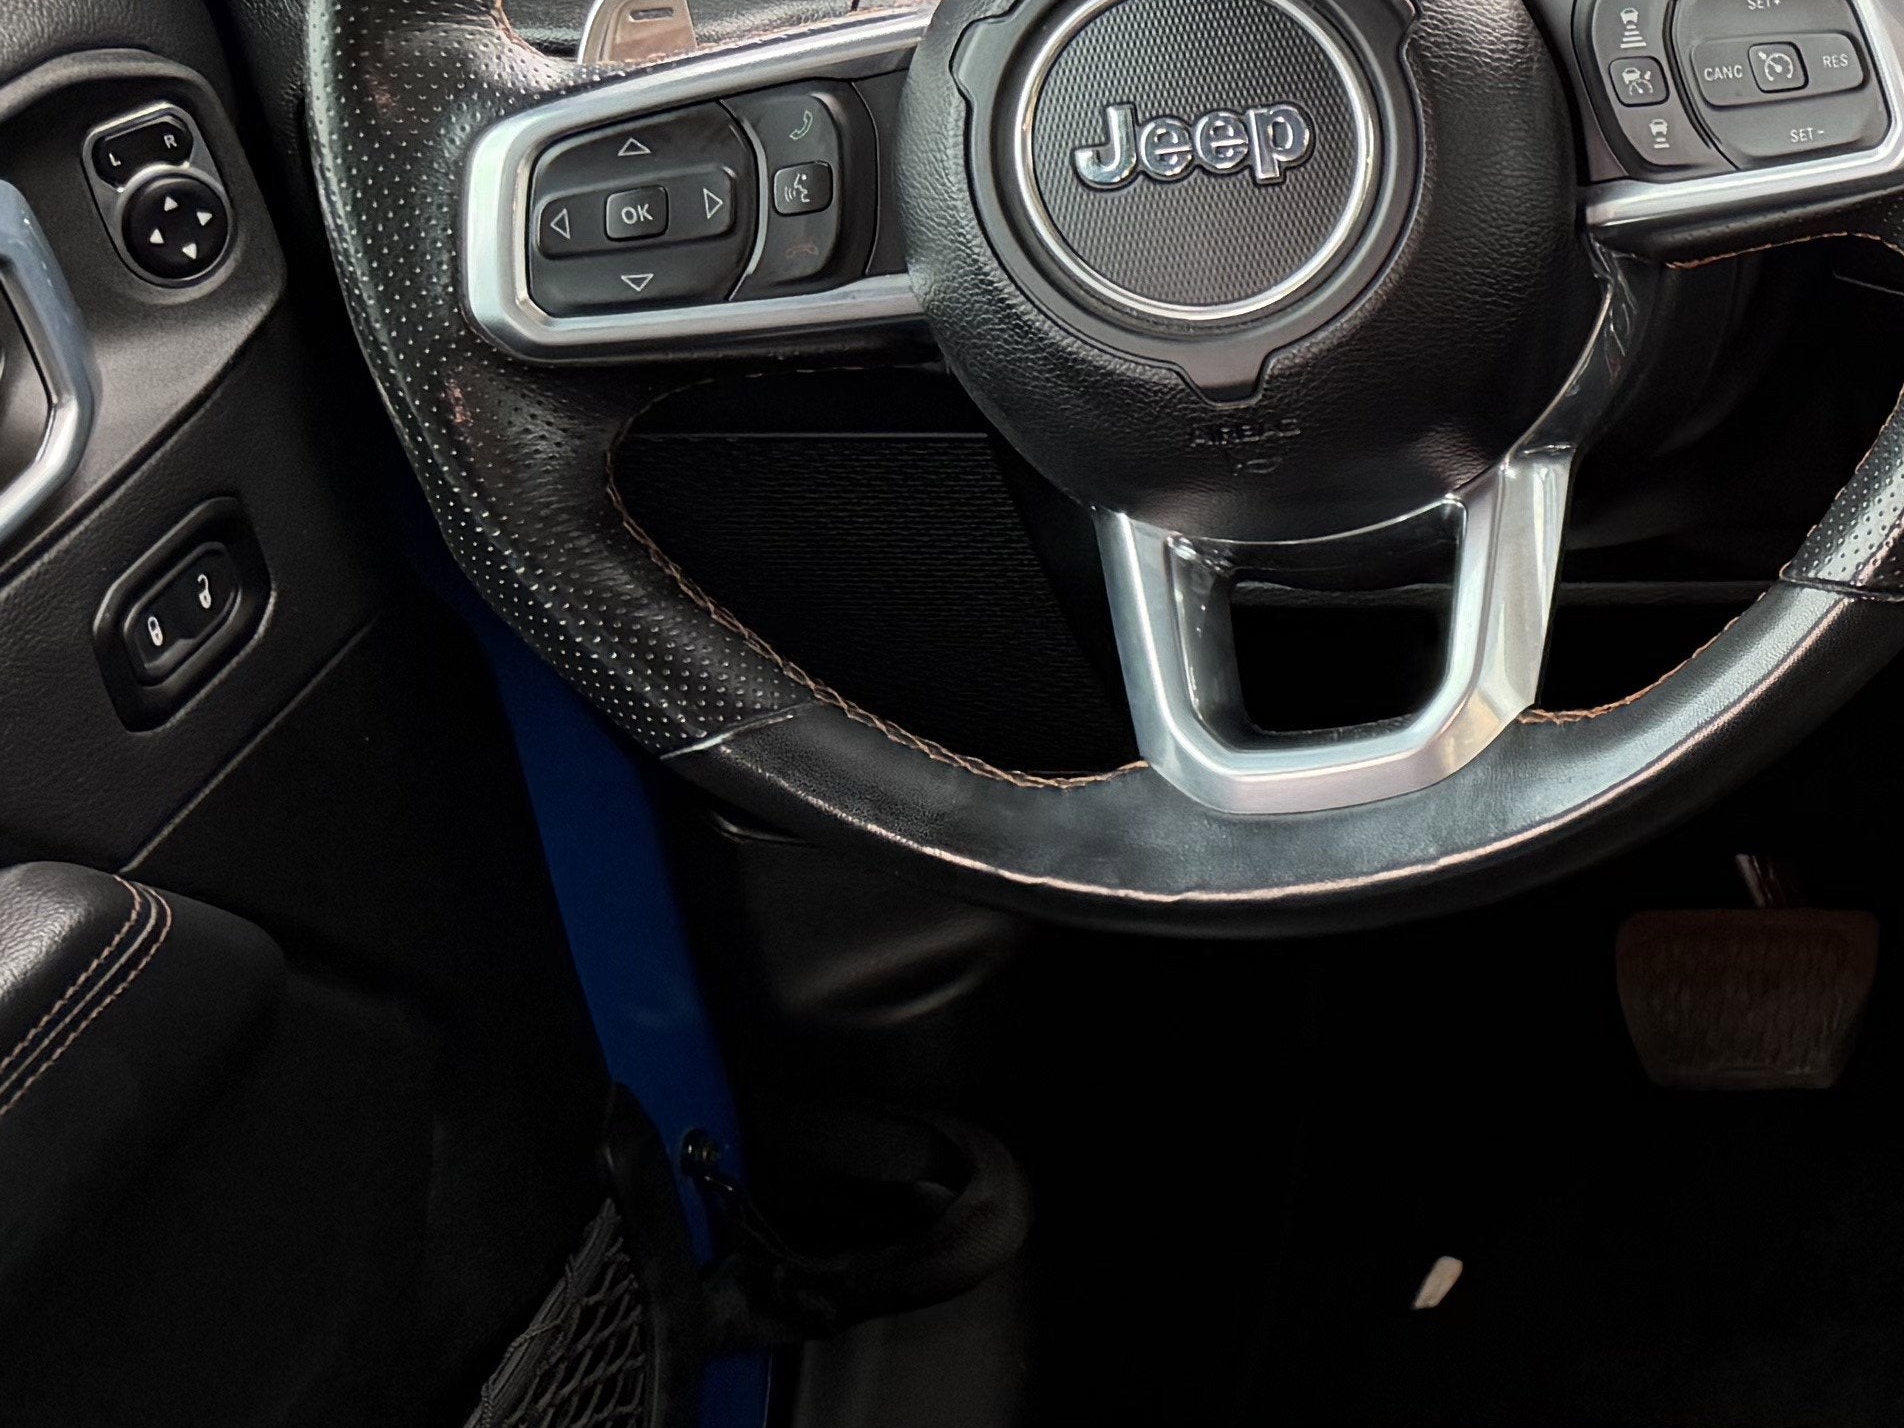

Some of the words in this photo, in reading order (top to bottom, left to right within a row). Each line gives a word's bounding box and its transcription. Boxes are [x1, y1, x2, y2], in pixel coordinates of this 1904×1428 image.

[1822, 54, 1849, 69] RES
[1703, 65, 1743, 82] CANC
[163, 134, 178, 149] R
[1073, 102, 1312, 187] Jeep
[108, 152, 122, 167] L
[620, 204, 654, 225] OK
